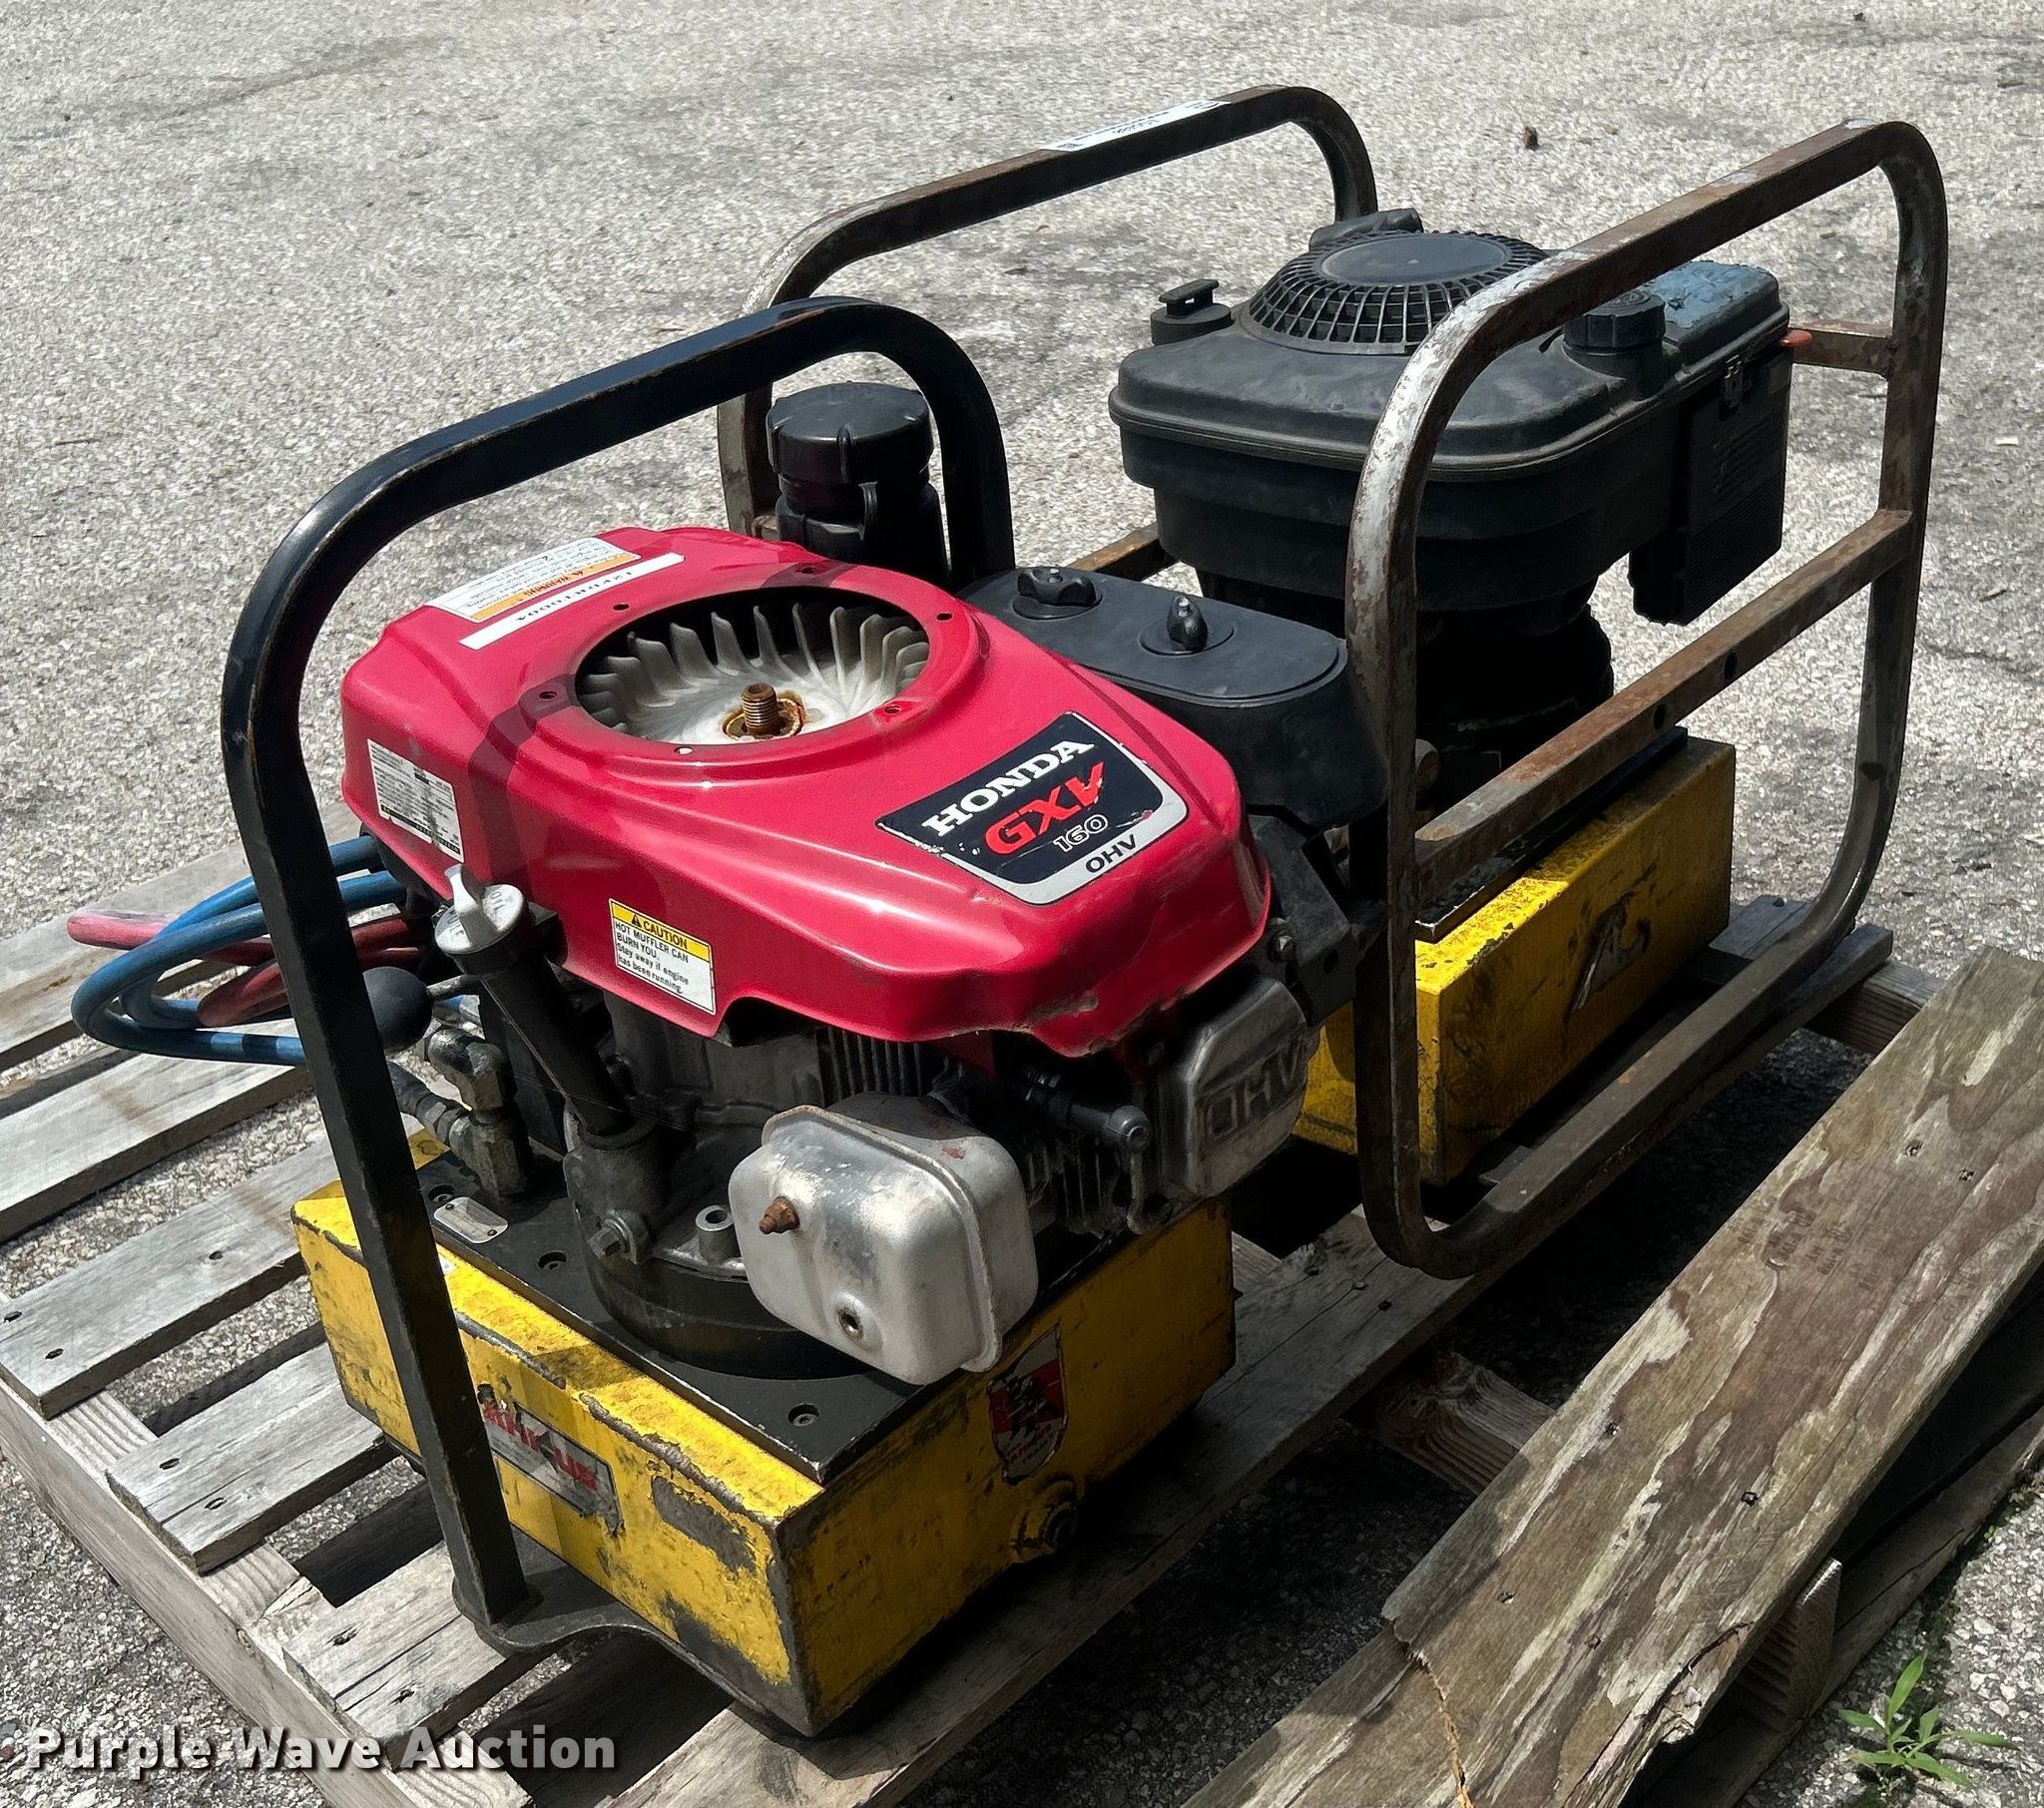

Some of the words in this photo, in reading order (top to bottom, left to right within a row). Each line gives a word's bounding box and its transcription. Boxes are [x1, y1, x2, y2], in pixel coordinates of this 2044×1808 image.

[921, 740, 1095, 837] HONDA
[985, 761, 1105, 854] GXV
[1053, 813, 1109, 853] 160
[1085, 834, 1136, 874] OHV
[615, 921, 632, 935] HOT
[634, 931, 670, 953] MUFFLER
[672, 949, 689, 963] CAN
[617, 932, 639, 949] BURN
[644, 921, 687, 949] CAUTION
[616, 942, 634, 959] Stay
[635, 953, 654, 969] away
[663, 967, 690, 986] engine
[618, 954, 632, 968] has
[633, 961, 651, 977] been
[1206, 1038, 1305, 1143] OHV
